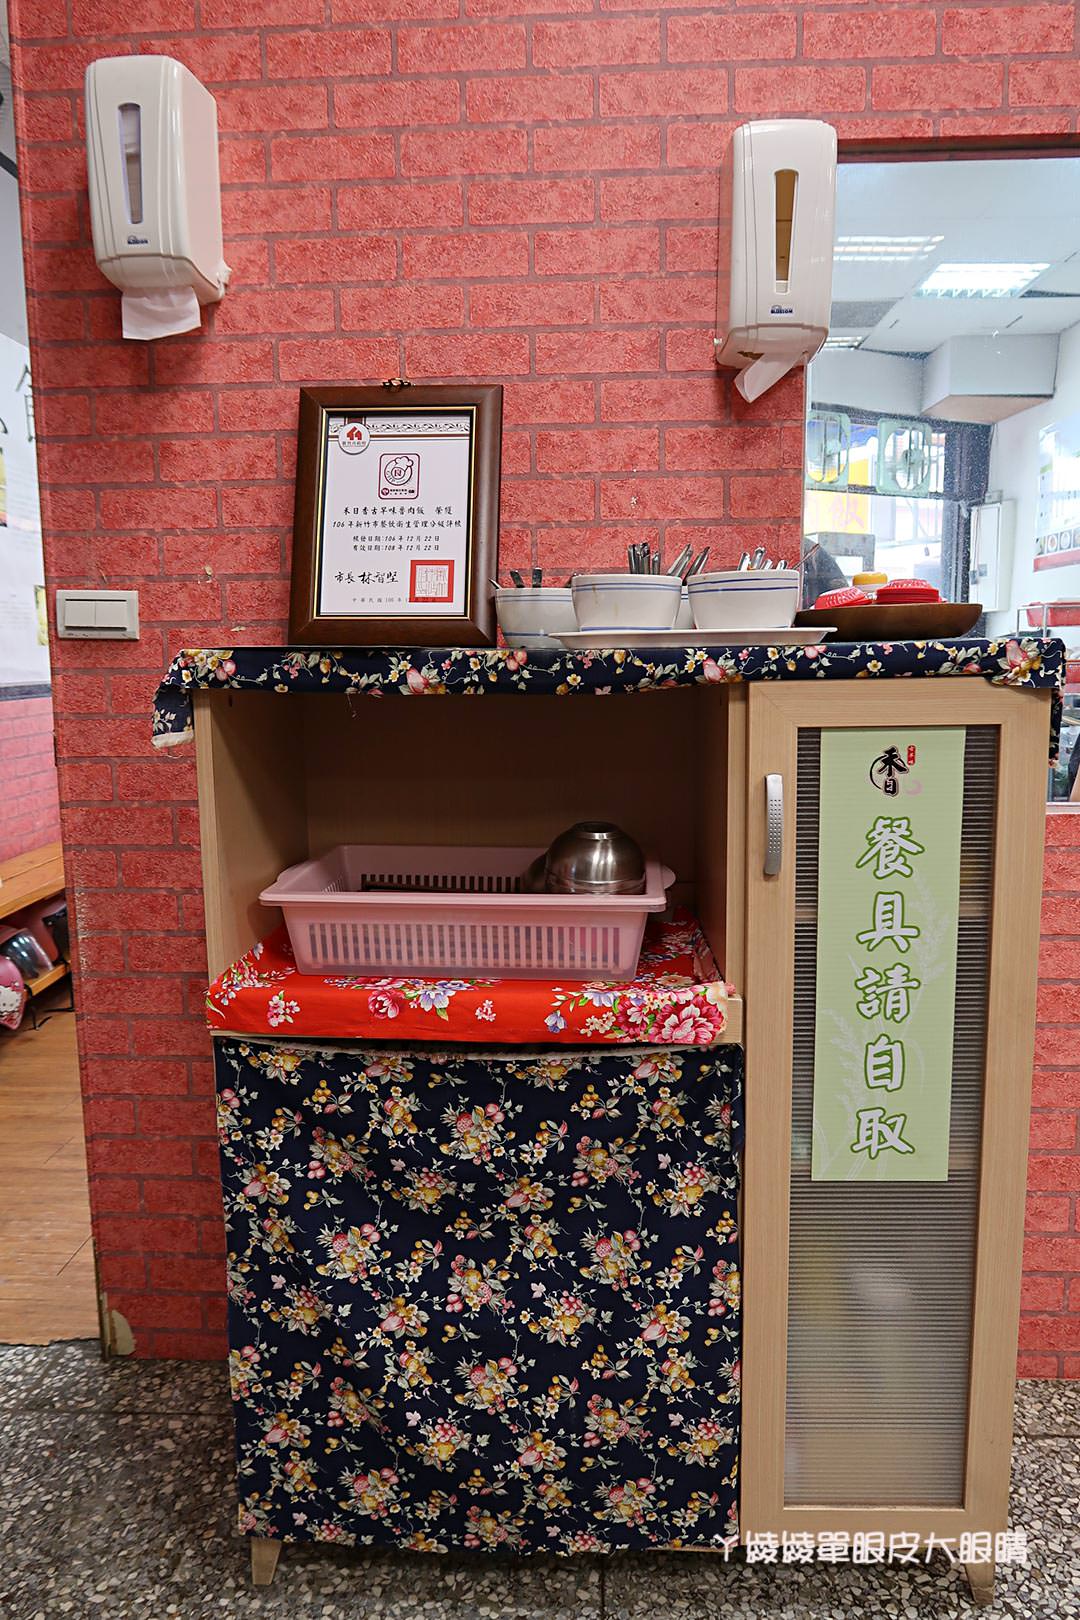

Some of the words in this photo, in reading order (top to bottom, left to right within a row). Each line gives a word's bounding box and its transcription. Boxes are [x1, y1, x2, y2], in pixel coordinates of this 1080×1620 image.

[851, 815, 925, 1159] 餐具請自取
